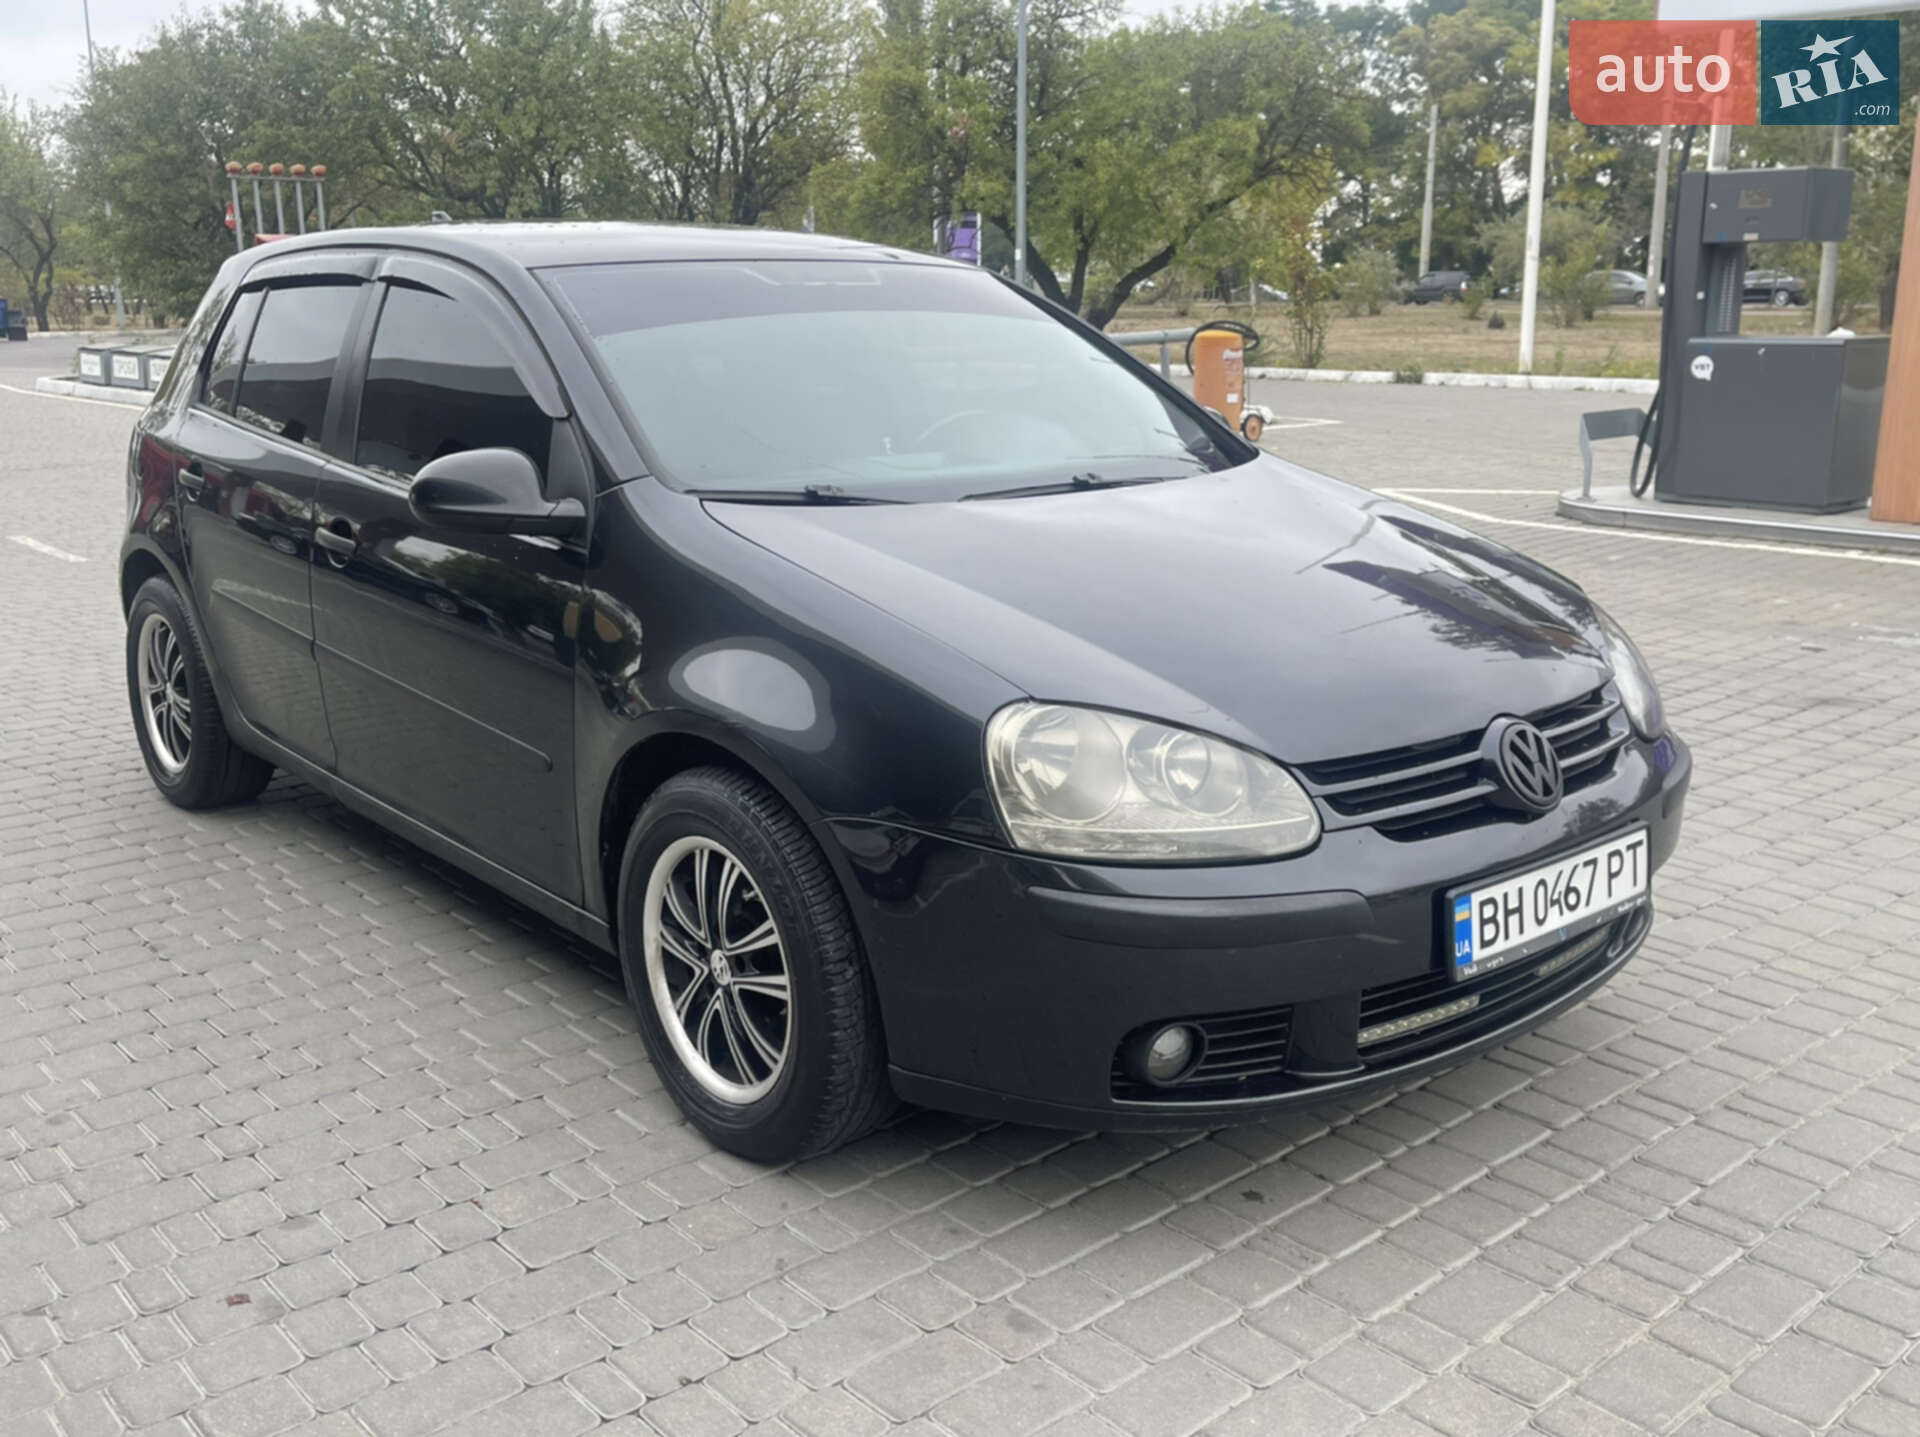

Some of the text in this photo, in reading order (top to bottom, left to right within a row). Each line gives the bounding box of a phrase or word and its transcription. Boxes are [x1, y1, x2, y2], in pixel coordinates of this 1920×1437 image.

[1478, 839, 1644, 950] BH 0467 PT
[1455, 939, 1471, 957] UA
